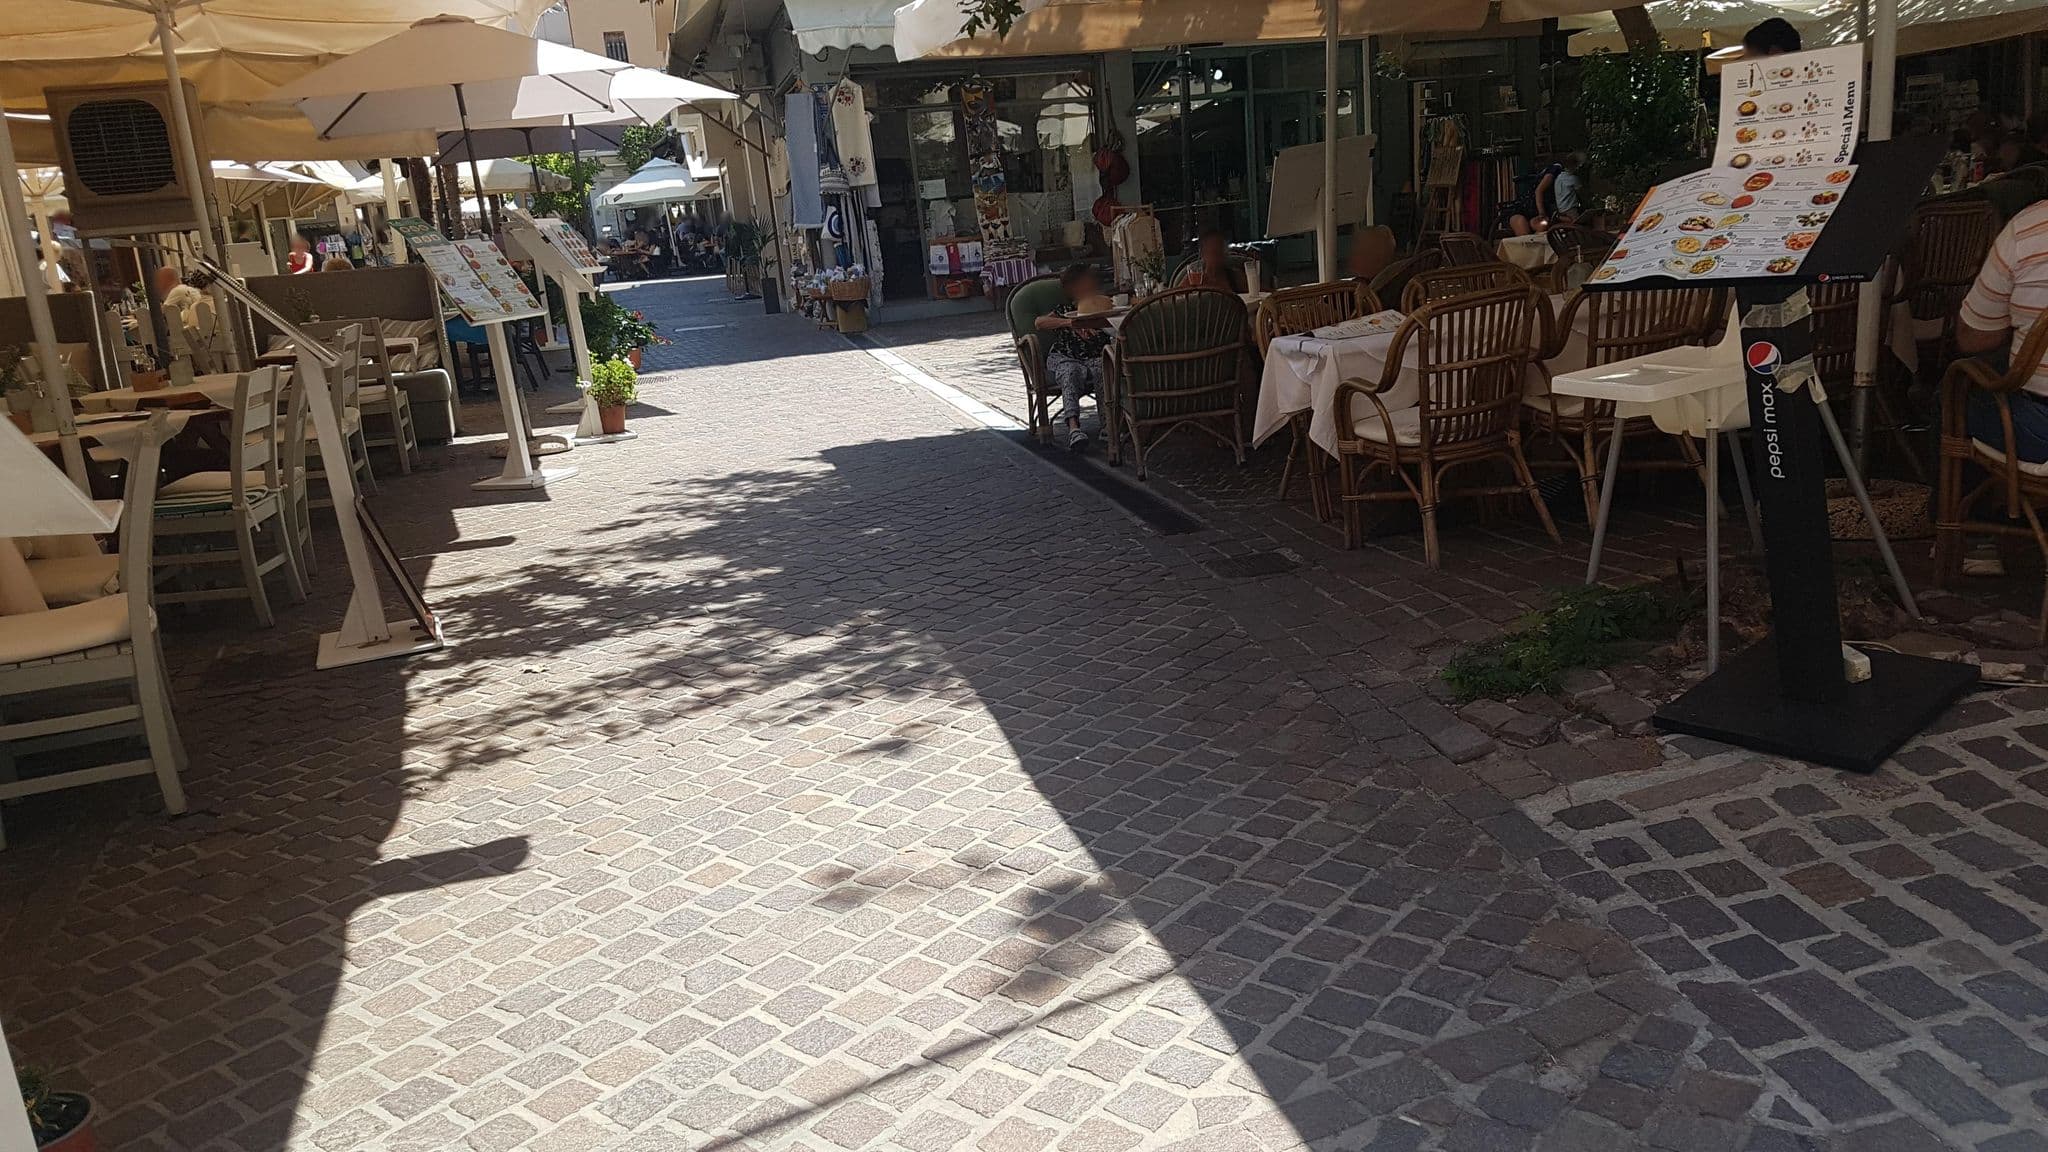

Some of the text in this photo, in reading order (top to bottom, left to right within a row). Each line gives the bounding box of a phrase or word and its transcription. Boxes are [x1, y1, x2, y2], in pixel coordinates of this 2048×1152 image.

[1834, 80, 1856, 163] Special Menu
[1761, 382, 1786, 479] pepsi max
